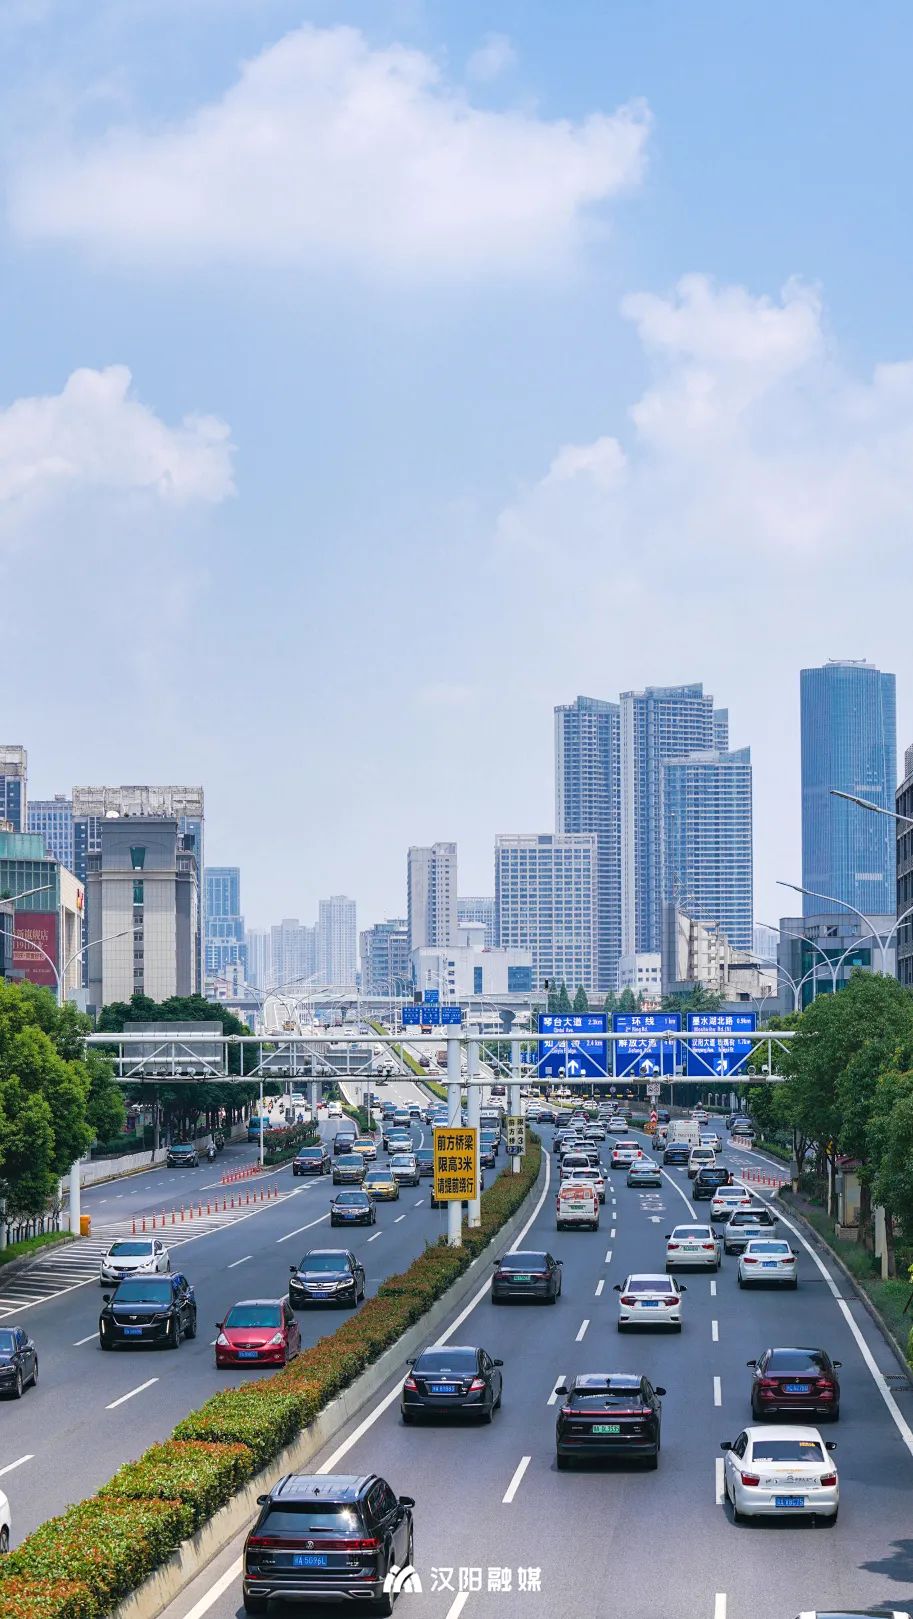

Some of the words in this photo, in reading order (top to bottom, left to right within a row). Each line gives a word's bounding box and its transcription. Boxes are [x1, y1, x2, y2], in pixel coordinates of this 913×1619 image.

[543, 1017, 583, 1027] 琴台大道
[617, 1017, 655, 1026] 二环线
[692, 1016, 733, 1026] 墨水湖北路
[618, 1039, 657, 1048] 解放大道
[691, 1038, 716, 1047] 汉阳大道
[437, 1134, 474, 1152] 前方桥梁
[437, 1156, 473, 1173] 限高3米
[437, 1177, 474, 1194] 请提前绕行
